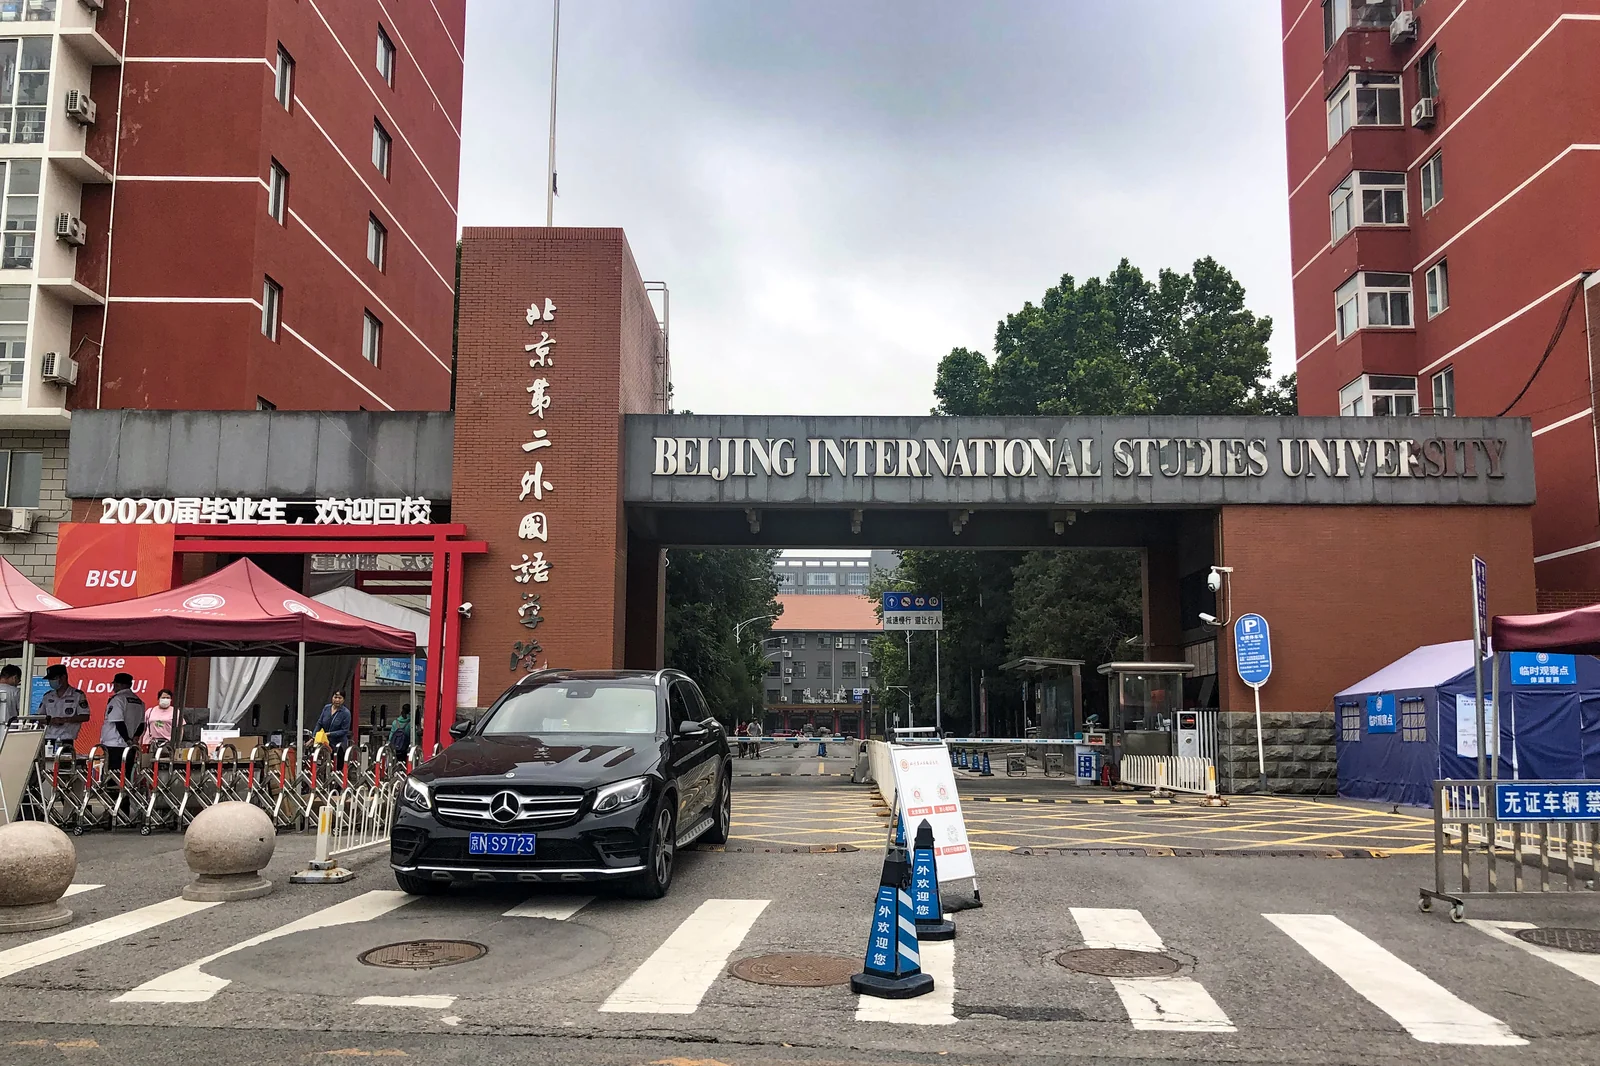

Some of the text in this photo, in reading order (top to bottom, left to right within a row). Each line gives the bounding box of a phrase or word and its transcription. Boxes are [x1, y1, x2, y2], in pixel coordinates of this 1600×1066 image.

[652, 436, 1507, 480] BEIJING INTERNATIONAL STUDIES UNIVERSITY
[99, 497, 432, 525] 2020届毕业生，欢迎回校
[85, 569, 137, 587] BISU
[60, 656, 125, 669] Because
[1519, 666, 1569, 676] 临时观察点
[86, 681, 115, 693] Lov
[916, 853, 930, 916] 二外欢迎您
[873, 890, 892, 966] 二外欢迎您
